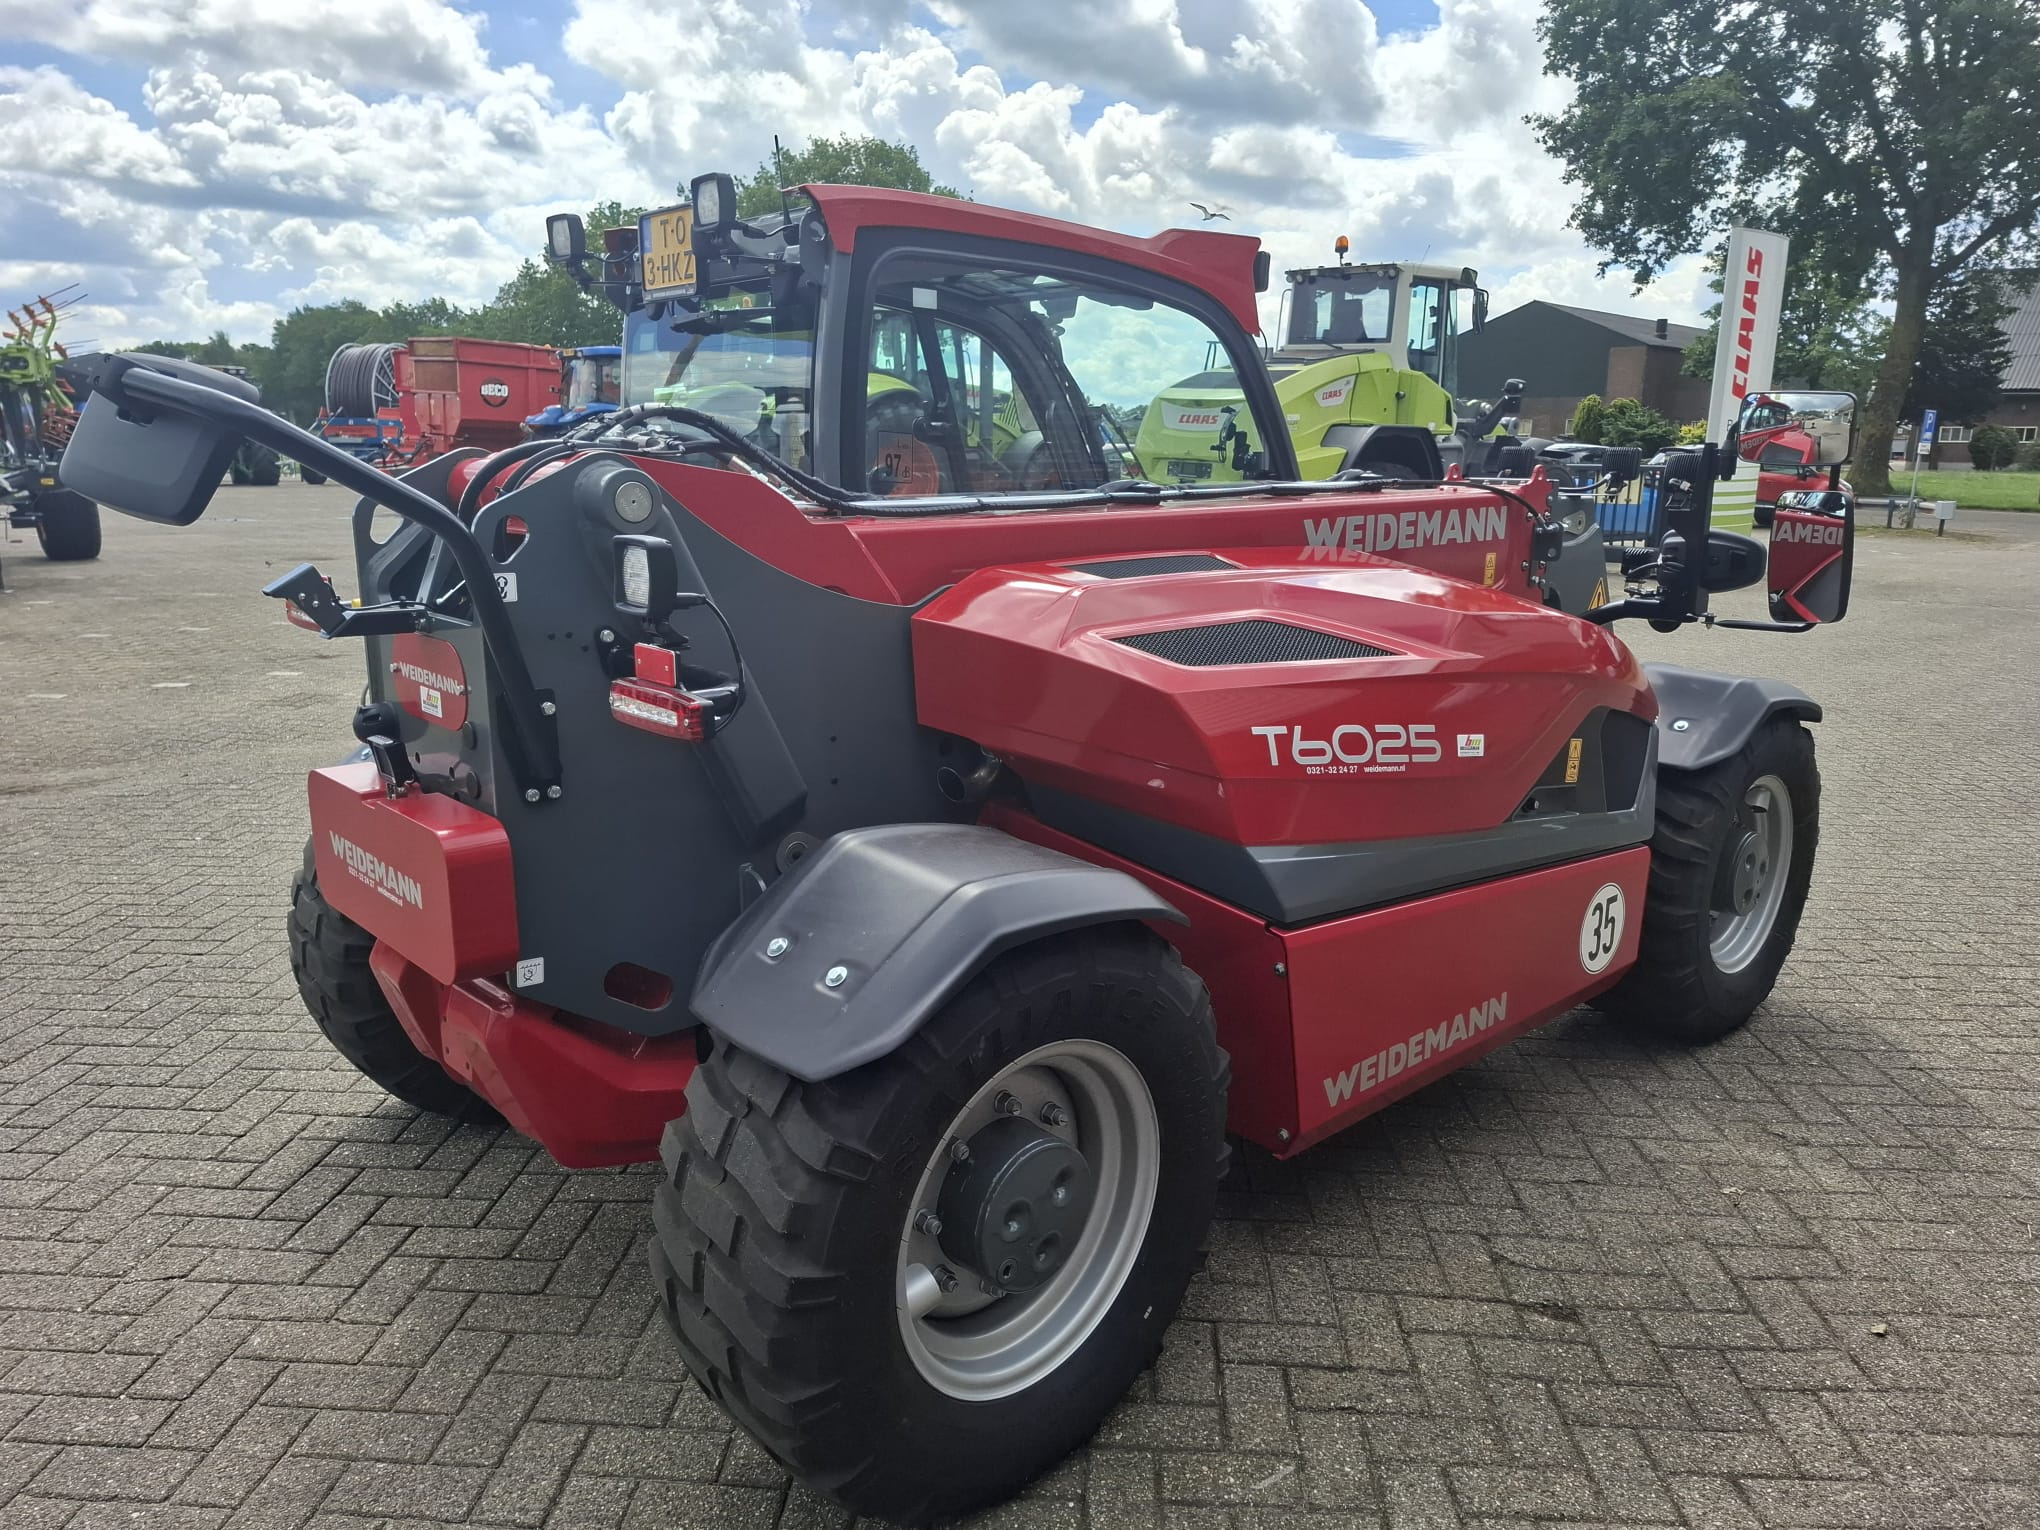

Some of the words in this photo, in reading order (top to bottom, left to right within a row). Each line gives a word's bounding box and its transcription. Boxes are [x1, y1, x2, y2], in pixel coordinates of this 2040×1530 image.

[1731, 246, 1763, 400] CLAAS
[481, 383, 509, 397] BECO
[1321, 388, 1343, 400] CLAAS
[1178, 413, 1219, 425] CLAAS
[1926, 412, 1934, 430] P
[885, 453, 901, 477] 97
[1304, 506, 1507, 554] WEIDEMANN
[399, 661, 460, 696] WEIDEMANN
[1251, 724, 1442, 766] T6025
[1306, 766, 1337, 775] 0321-32
[1338, 765, 1348, 774] 24
[1349, 765, 1358, 774] 27
[1363, 764, 1406, 773] weidemann.nl
[329, 829, 423, 910] WEIDEMANN
[1588, 894, 1619, 962] 35
[1323, 992, 1508, 1108] WEIDEMANN
